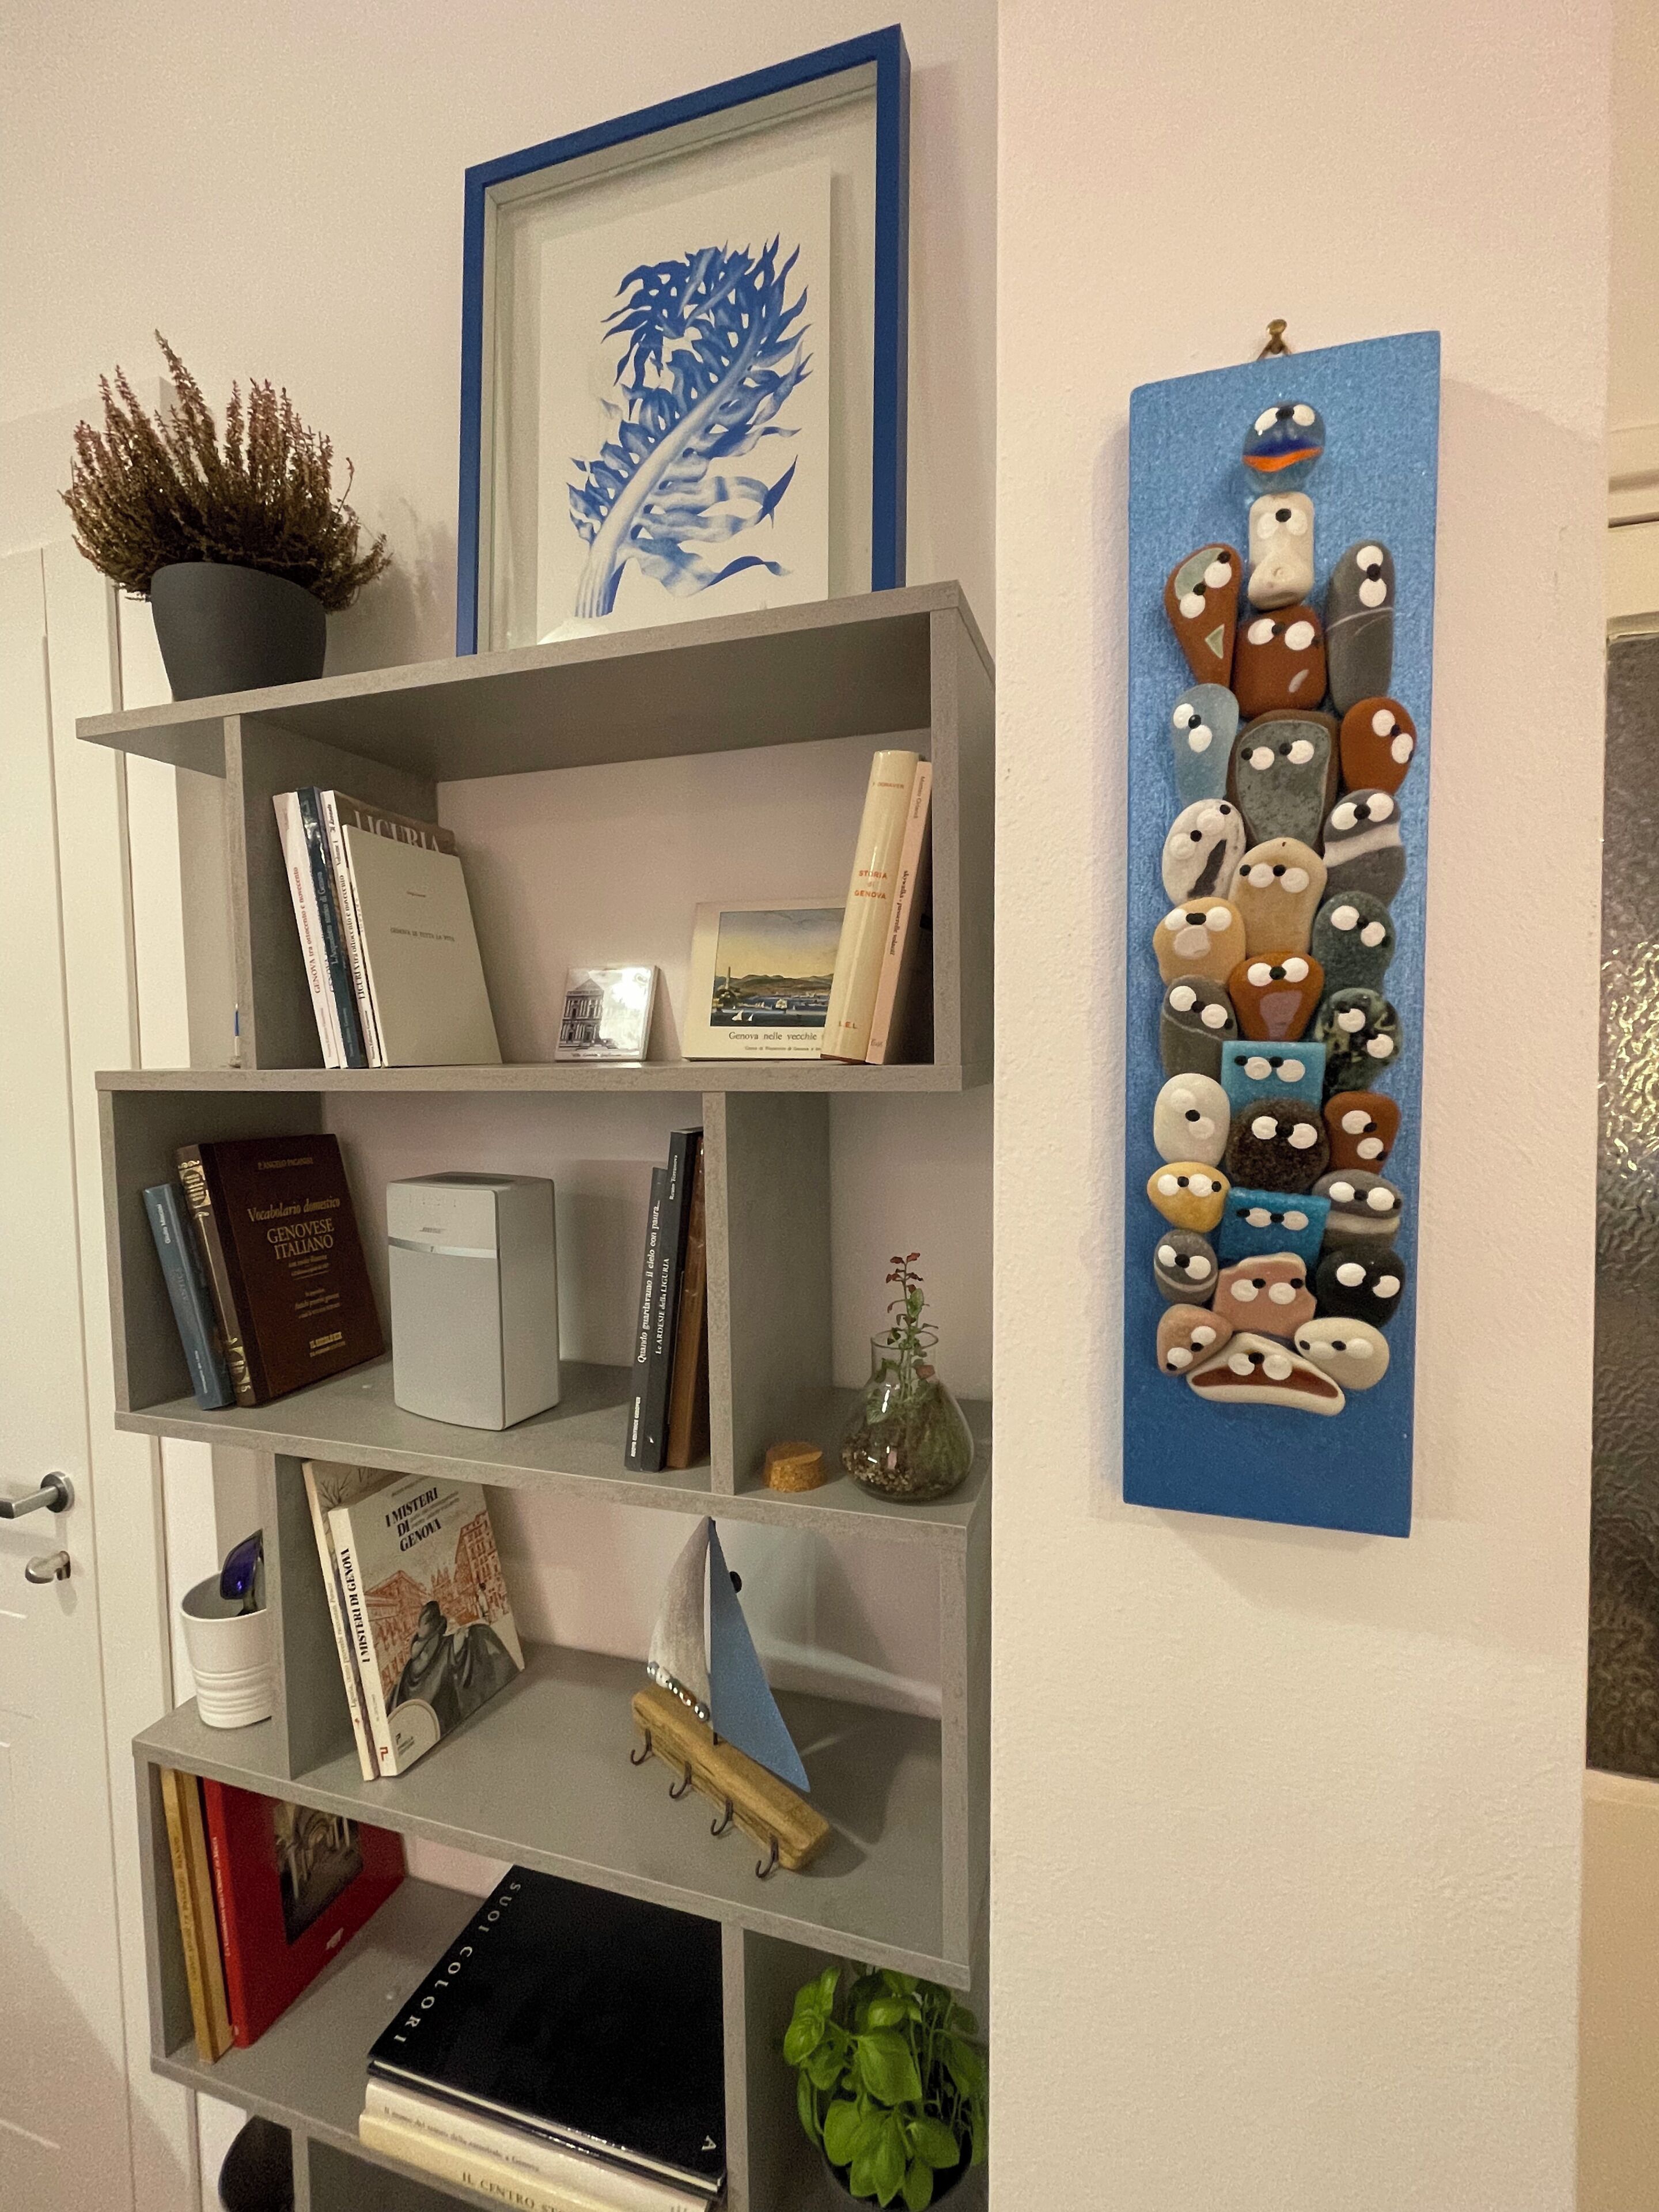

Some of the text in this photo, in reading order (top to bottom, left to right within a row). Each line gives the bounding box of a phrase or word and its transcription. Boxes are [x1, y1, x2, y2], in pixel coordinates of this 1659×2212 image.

[294, 867, 304, 903] novecento
[318, 871, 326, 895] Genova
[858, 870, 887, 880] STORIA
[854, 890, 886, 900] GENOVA
[301, 911, 313, 945] ottocento
[308, 959, 320, 993] GENOVA
[353, 965, 365, 999] LIGURIA
[729, 1031, 817, 1041] Genova nelle vecchie
[247, 1195, 340, 1222] Vocabolario domestico
[267, 1218, 335, 1244] GENOVESE
[274, 1234, 334, 1260] ITALIANO
[656, 1258, 670, 1355] Le ARDESIE della LIGURIA
[637, 1332, 647, 1363] Quando
[385, 1514, 391, 1528] I
[392, 1487, 439, 1524] MISTERI
[397, 1519, 410, 1537] DI
[400, 1518, 442, 1552] GENOVA
[340, 1548, 357, 1592] GENOVA
[349, 1593, 359, 1606] DI
[351, 1608, 369, 1657] MISTERI
[393, 1882, 521, 2043] SUOI COLORI
[462, 2172, 473, 2184] IL
[480, 2179, 536, 2209] CENTRO
